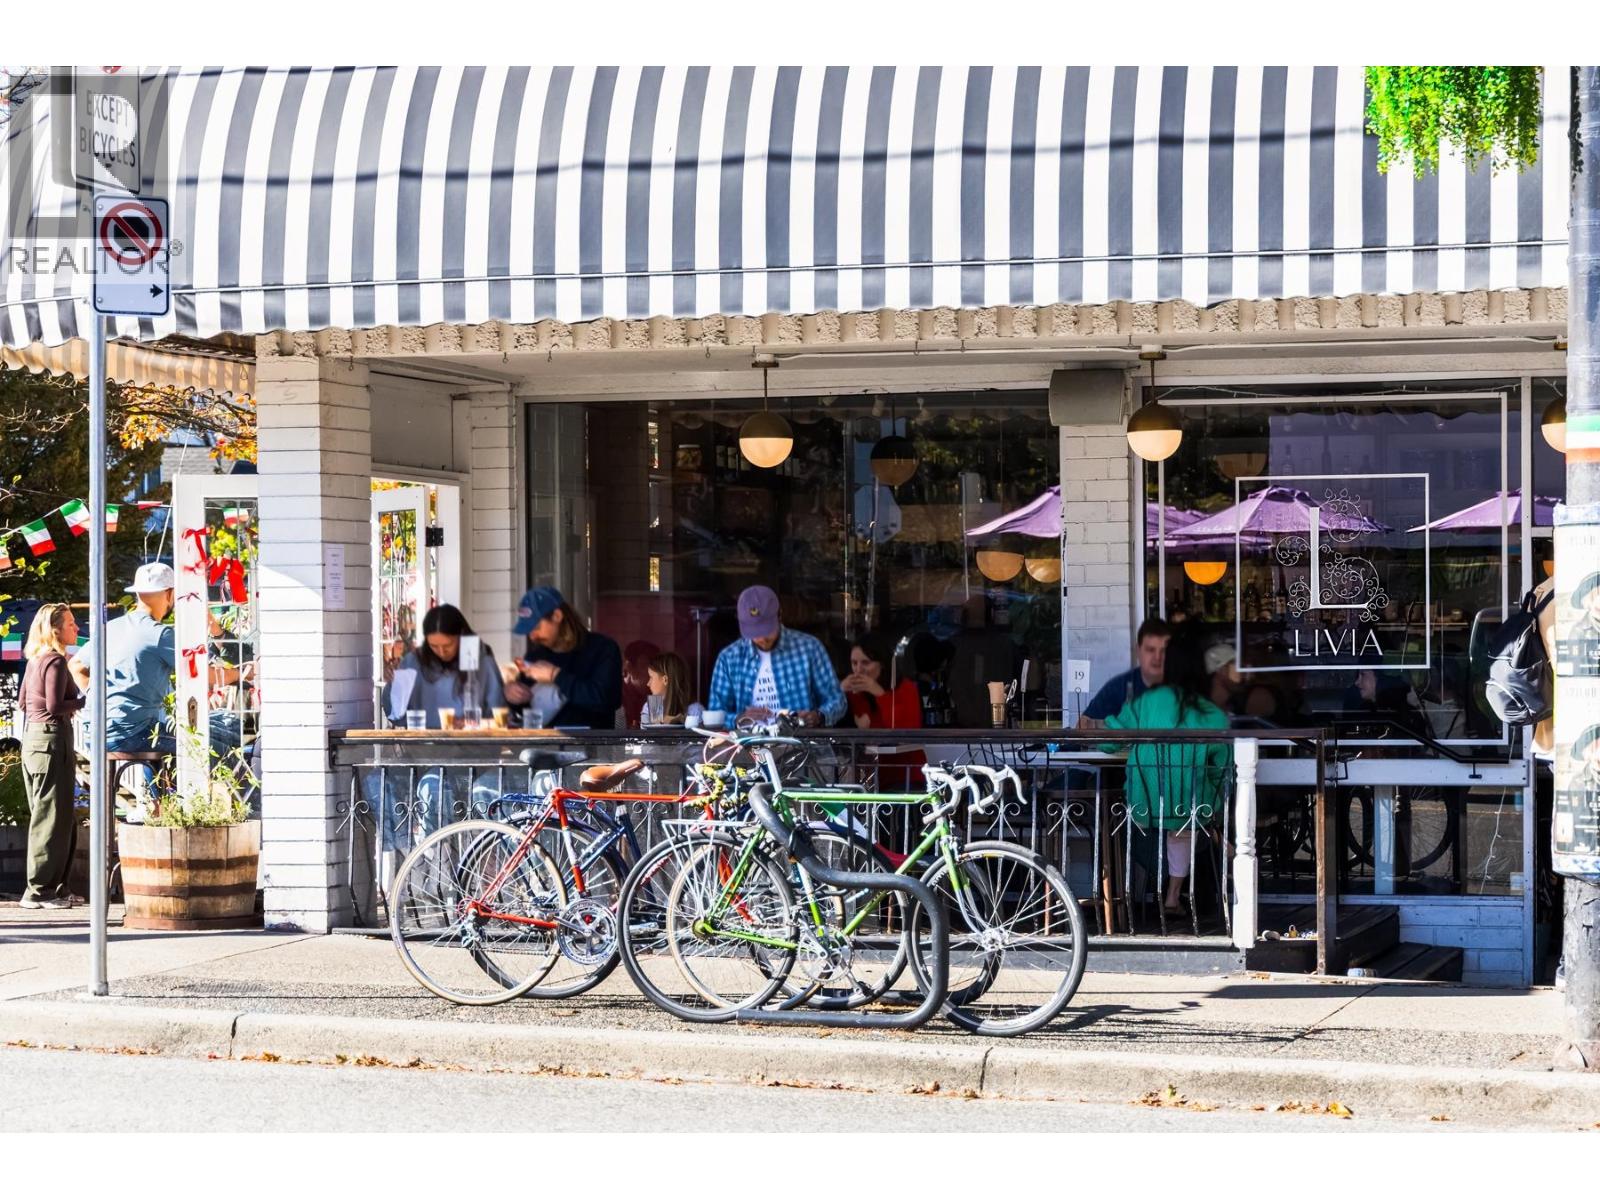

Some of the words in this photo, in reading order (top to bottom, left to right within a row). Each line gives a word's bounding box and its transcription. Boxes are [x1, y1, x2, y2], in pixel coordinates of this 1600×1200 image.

[86, 90, 130, 127] EXCEPT
[80, 127, 136, 167] BICYCLES
[1295, 629, 1384, 656] LIVIA
[1074, 671, 1085, 680] 19
